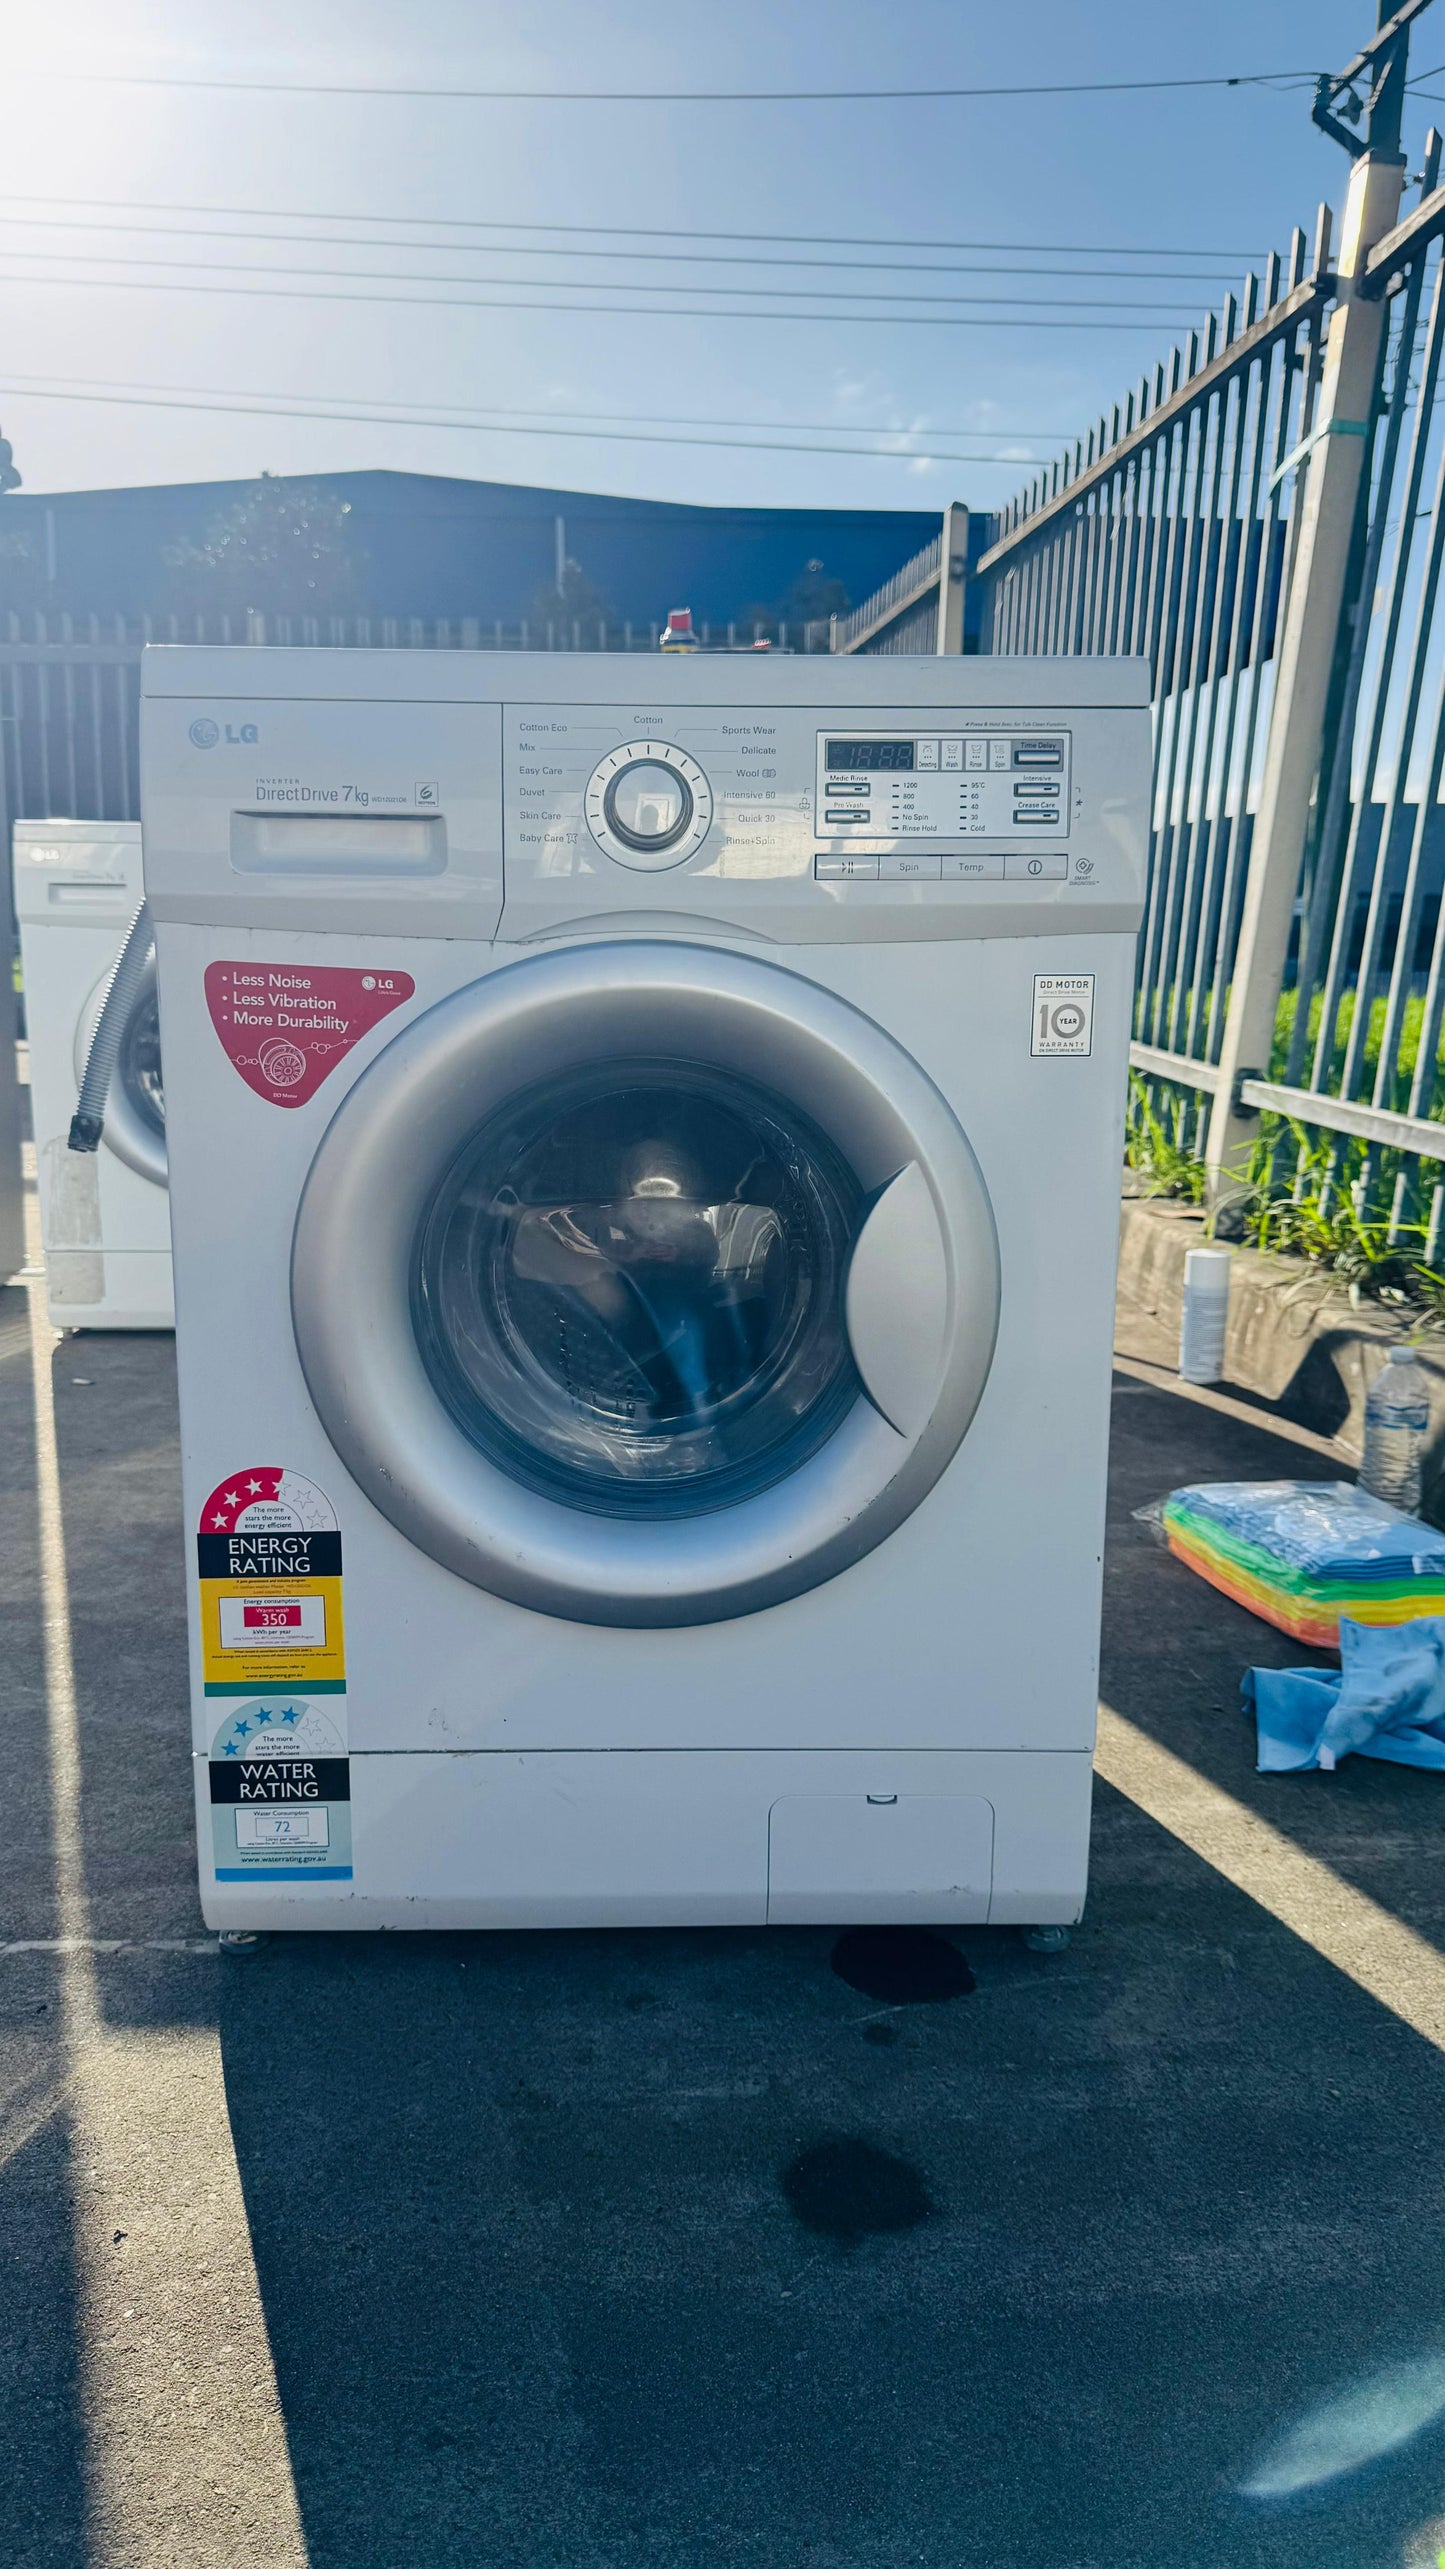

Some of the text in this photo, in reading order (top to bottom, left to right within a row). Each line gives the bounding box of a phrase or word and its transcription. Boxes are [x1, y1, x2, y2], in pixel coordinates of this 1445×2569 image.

[633, 716, 663, 724] Cotton
[520, 723, 567, 732] Cotton Eco
[722, 725, 776, 735] Sports Wear
[225, 724, 259, 744] LG
[519, 743, 536, 751] Mix
[741, 746, 776, 755] Delicate
[1038, 742, 1056, 750] Delay
[995, 761, 1006, 769] Spin
[519, 766, 563, 776] Easy Care
[736, 769, 760, 778] Wool
[520, 788, 545, 796] Duvet
[723, 791, 776, 799] Intensive 60
[520, 812, 561, 820] Skin Care
[738, 814, 776, 823] Quick 30
[913, 814, 929, 822] Spin
[520, 834, 564, 843] Baby Care
[726, 837, 776, 846] Rinse+Spin
[899, 863, 919, 872] Spin
[958, 863, 984, 872] Temp
[233, 972, 312, 989] Less Noise
[378, 979, 394, 989] LG
[1040, 981, 1089, 989] DD MOTOR
[233, 992, 337, 1010] Less Vibration
[234, 1011, 349, 1033] More Durability
[1040, 1003, 1085, 1039] 10
[229, 1537, 312, 1555] ENERGY
[230, 1557, 311, 1574] RATING
[262, 1614, 287, 1626] 350
[240, 1764, 316, 1780] WATER
[240, 1782, 318, 1798] RATING
[275, 1821, 291, 1833] 72
[241, 1856, 327, 1864] www.waterrating.gov.au
